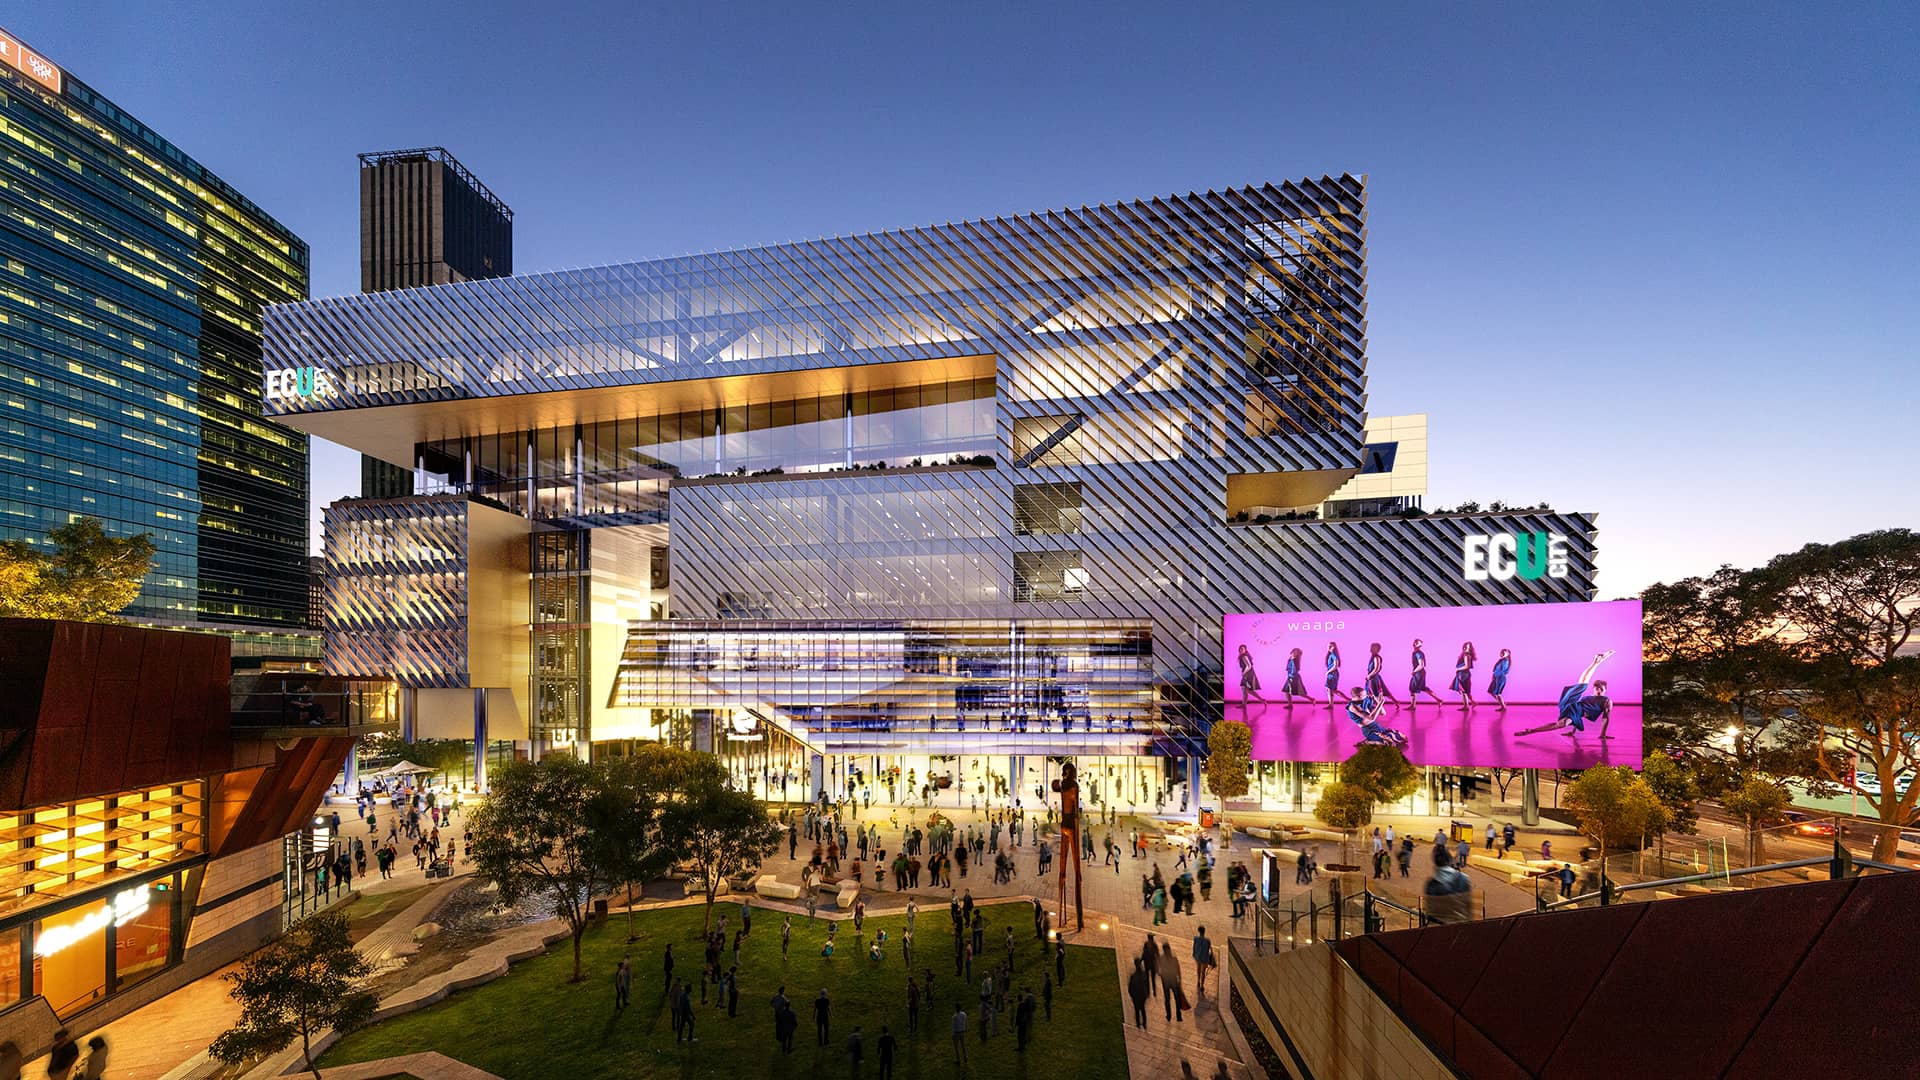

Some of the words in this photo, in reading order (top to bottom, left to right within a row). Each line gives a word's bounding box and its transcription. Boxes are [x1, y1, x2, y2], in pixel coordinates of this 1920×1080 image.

[267, 367, 314, 399] ECU
[1464, 530, 1547, 580] ECU
[1548, 532, 1568, 578] CITY
[1288, 621, 1345, 632] waapa
